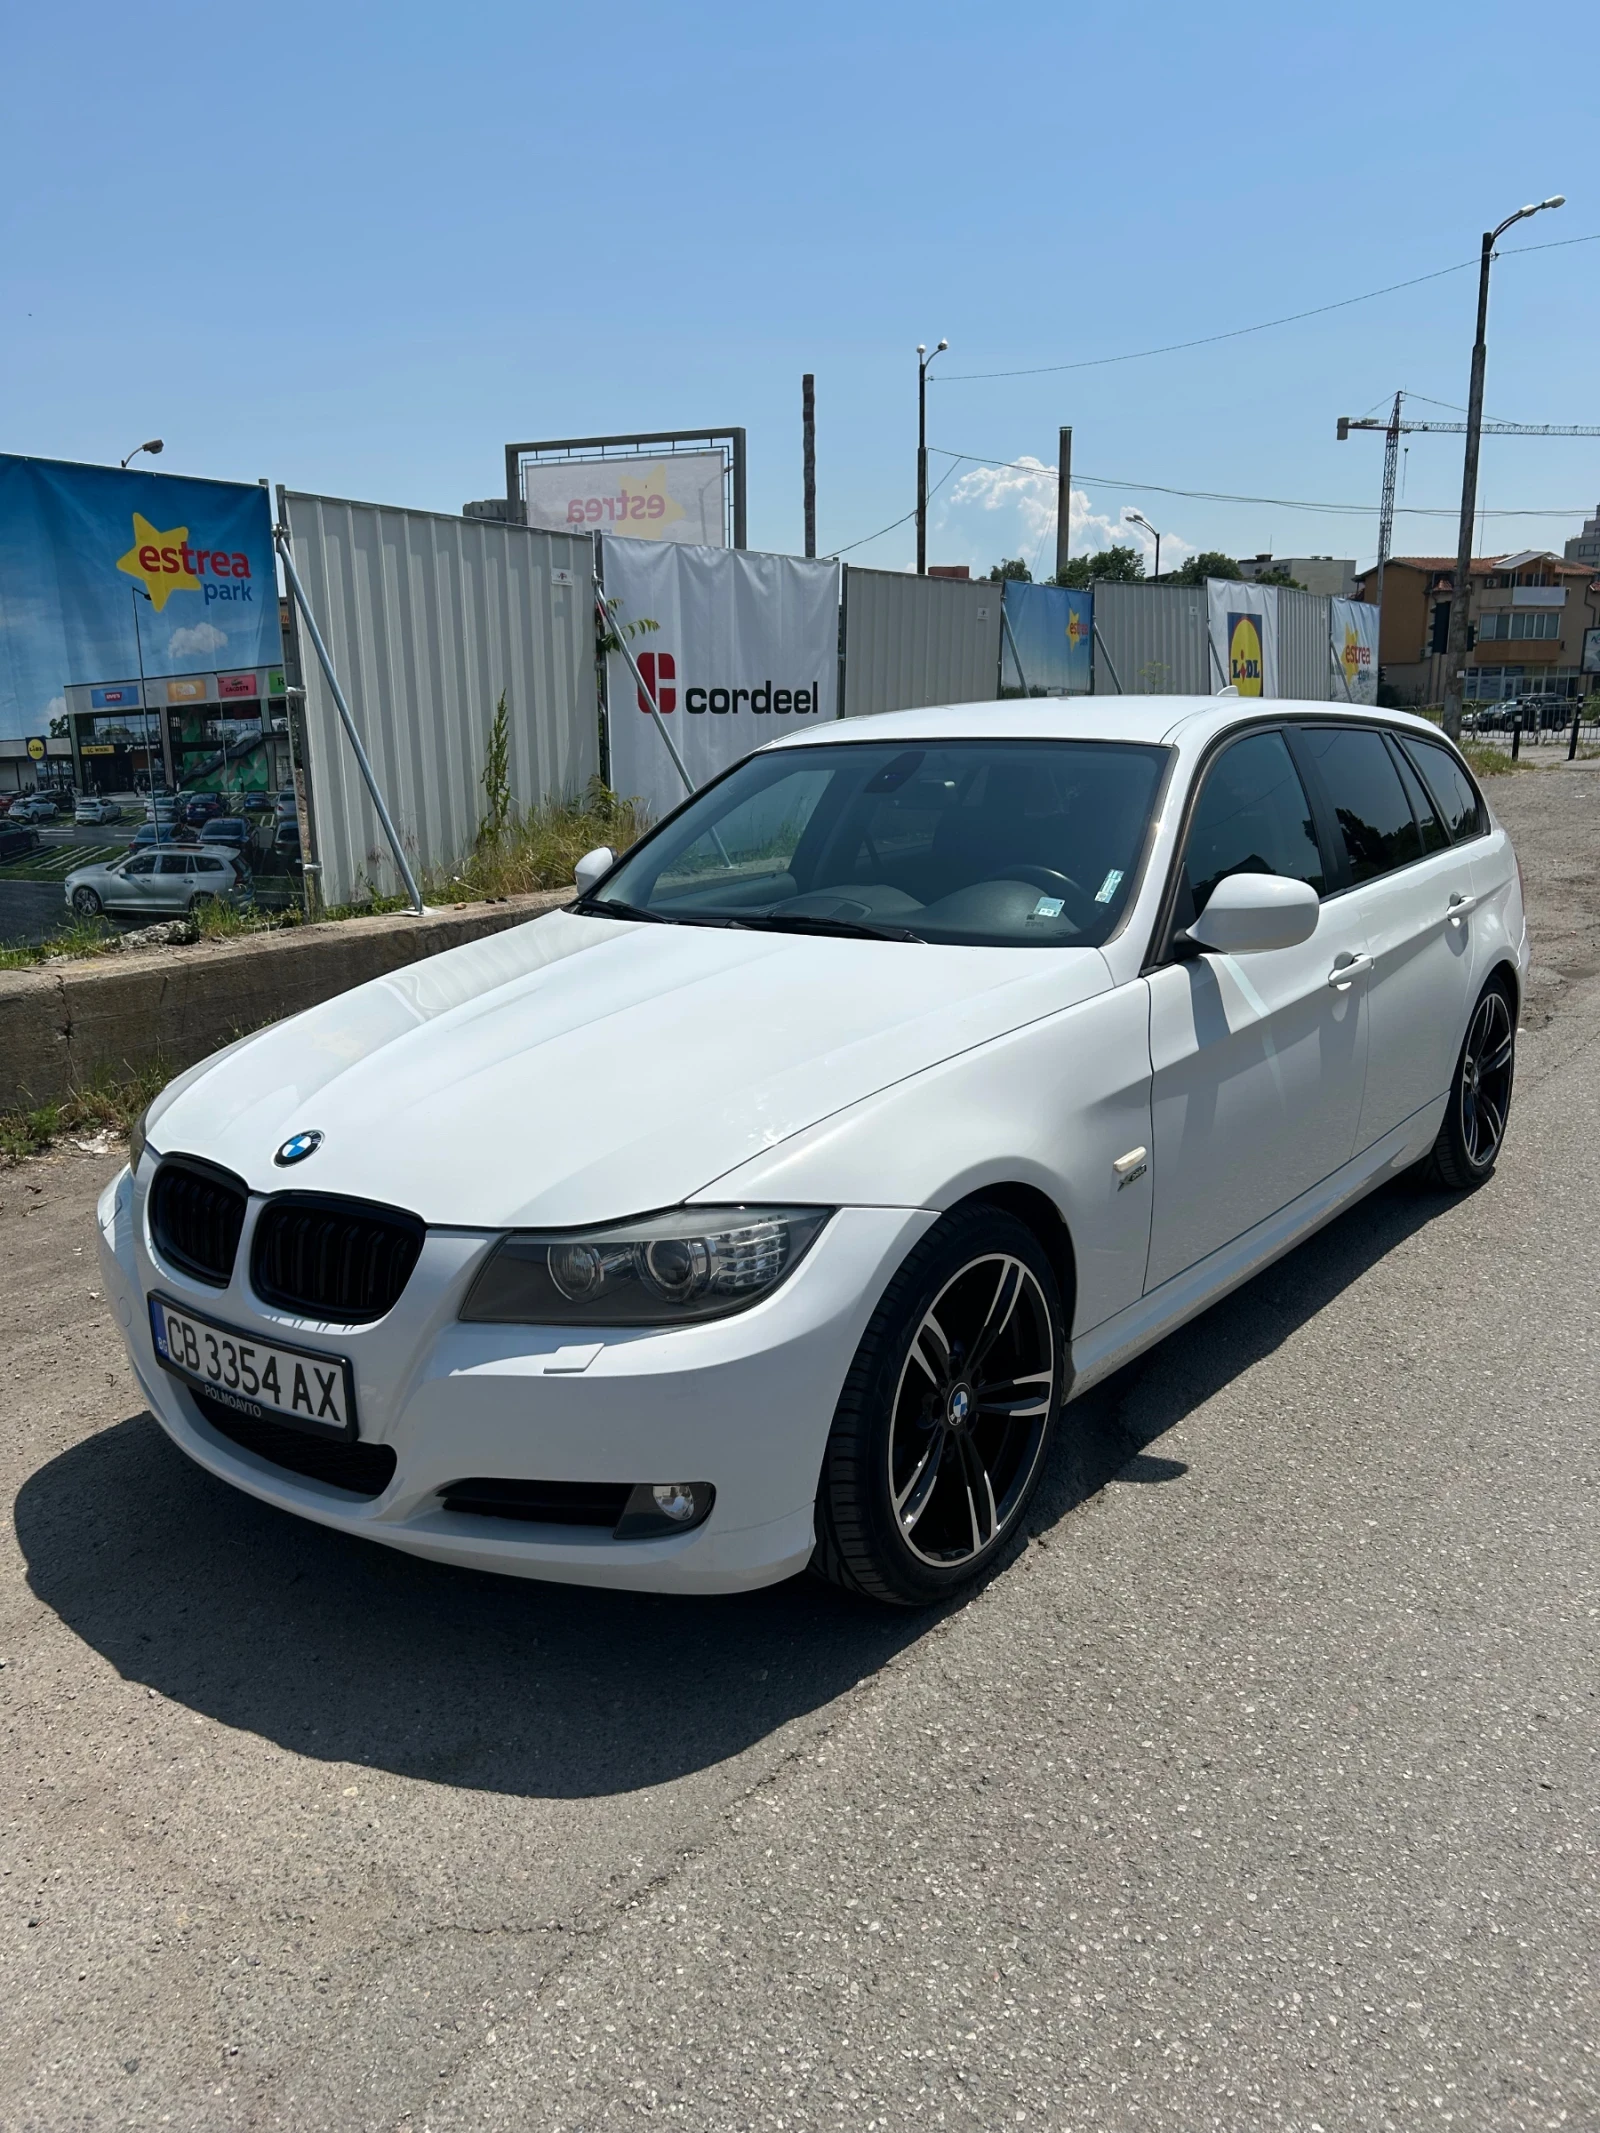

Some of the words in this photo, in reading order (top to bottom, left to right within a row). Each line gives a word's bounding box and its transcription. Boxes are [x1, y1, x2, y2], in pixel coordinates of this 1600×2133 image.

[139, 541, 251, 578] estrea
[203, 580, 253, 605] park
[1345, 644, 1371, 665] estrea
[685, 680, 818, 715] cordeel
[157, 1336, 168, 1353] BG
[167, 1316, 200, 1371] CB
[205, 1334, 281, 1405] 3354
[292, 1363, 341, 1422] AX
